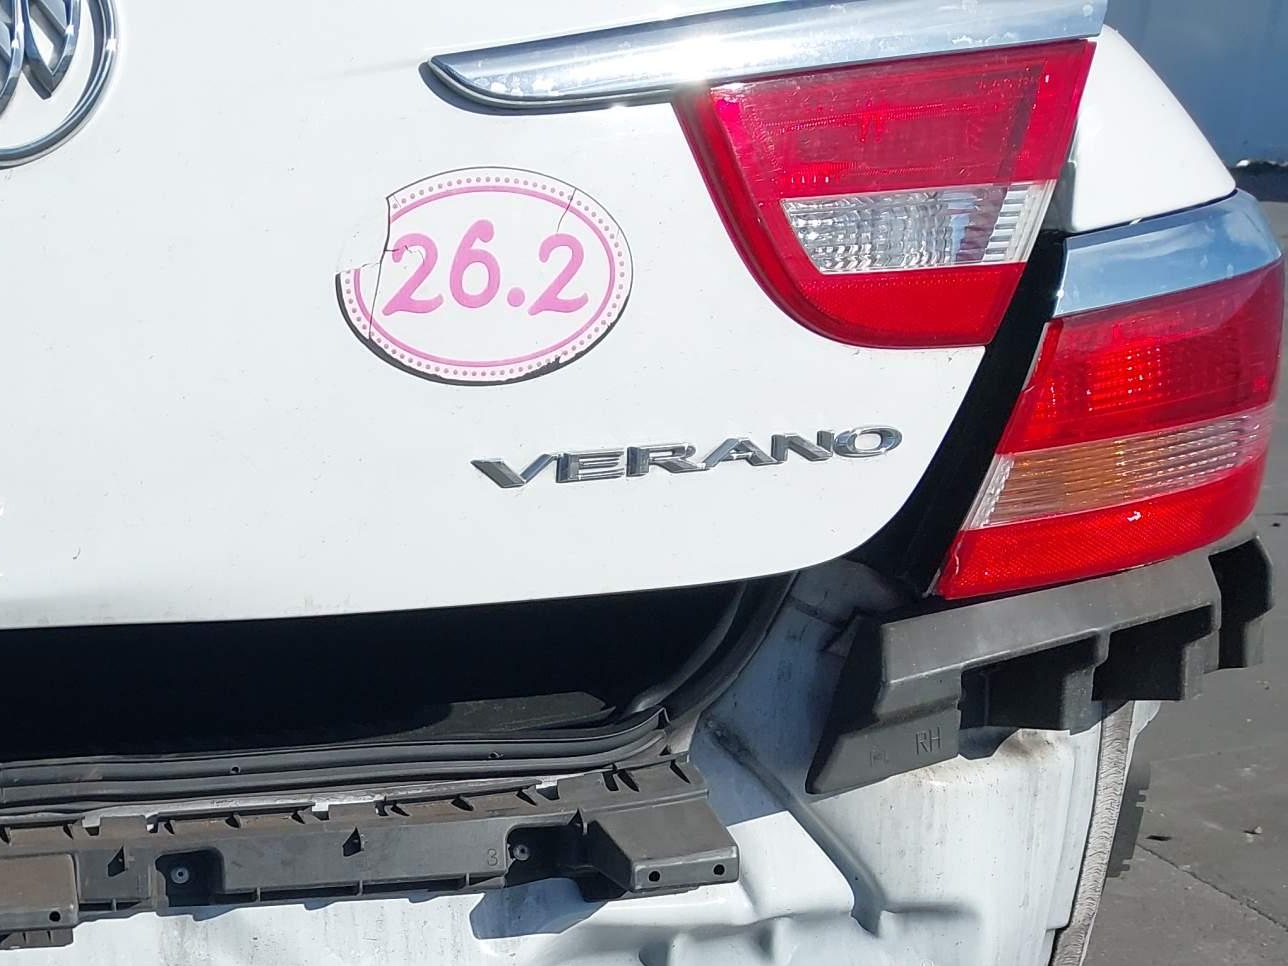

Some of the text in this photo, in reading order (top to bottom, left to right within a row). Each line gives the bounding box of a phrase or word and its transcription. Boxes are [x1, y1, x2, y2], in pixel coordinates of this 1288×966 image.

[381, 219, 589, 317] 26.2
[470, 424, 903, 488] VERANO
[914, 726, 943, 755] RH
